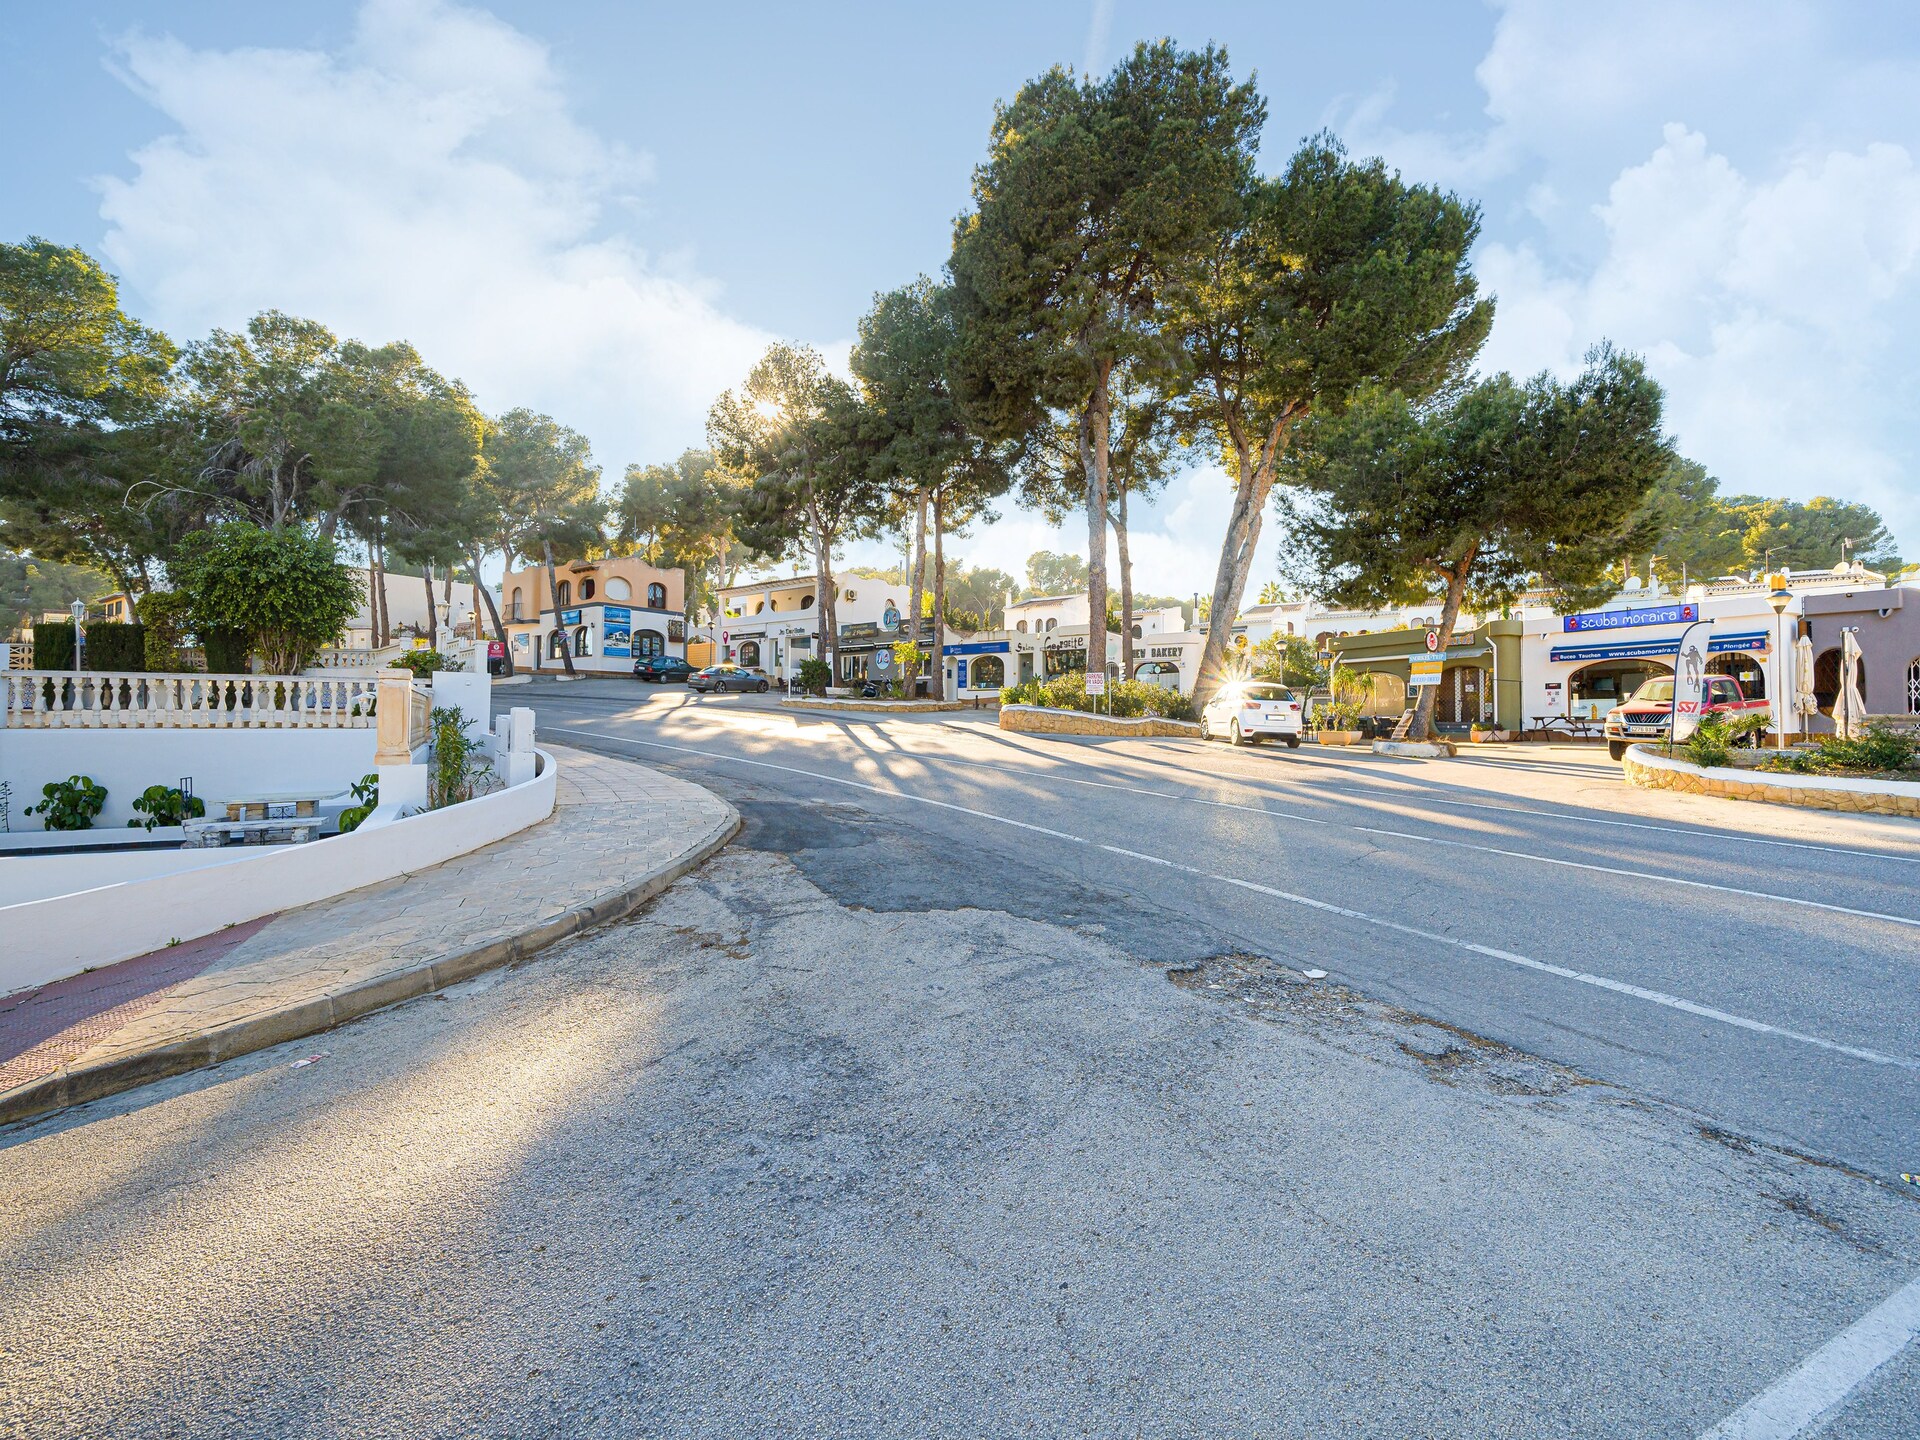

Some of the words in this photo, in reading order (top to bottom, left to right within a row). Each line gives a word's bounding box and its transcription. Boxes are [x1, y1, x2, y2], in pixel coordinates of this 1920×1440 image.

[1581, 613, 1618, 629] scuba
[1622, 610, 1677, 625] moraira
[1015, 642, 1035, 653] Salon
[1044, 636, 1084, 652] Georgette
[1151, 646, 1184, 658] BAKERY
[1677, 701, 1699, 713] SSI
